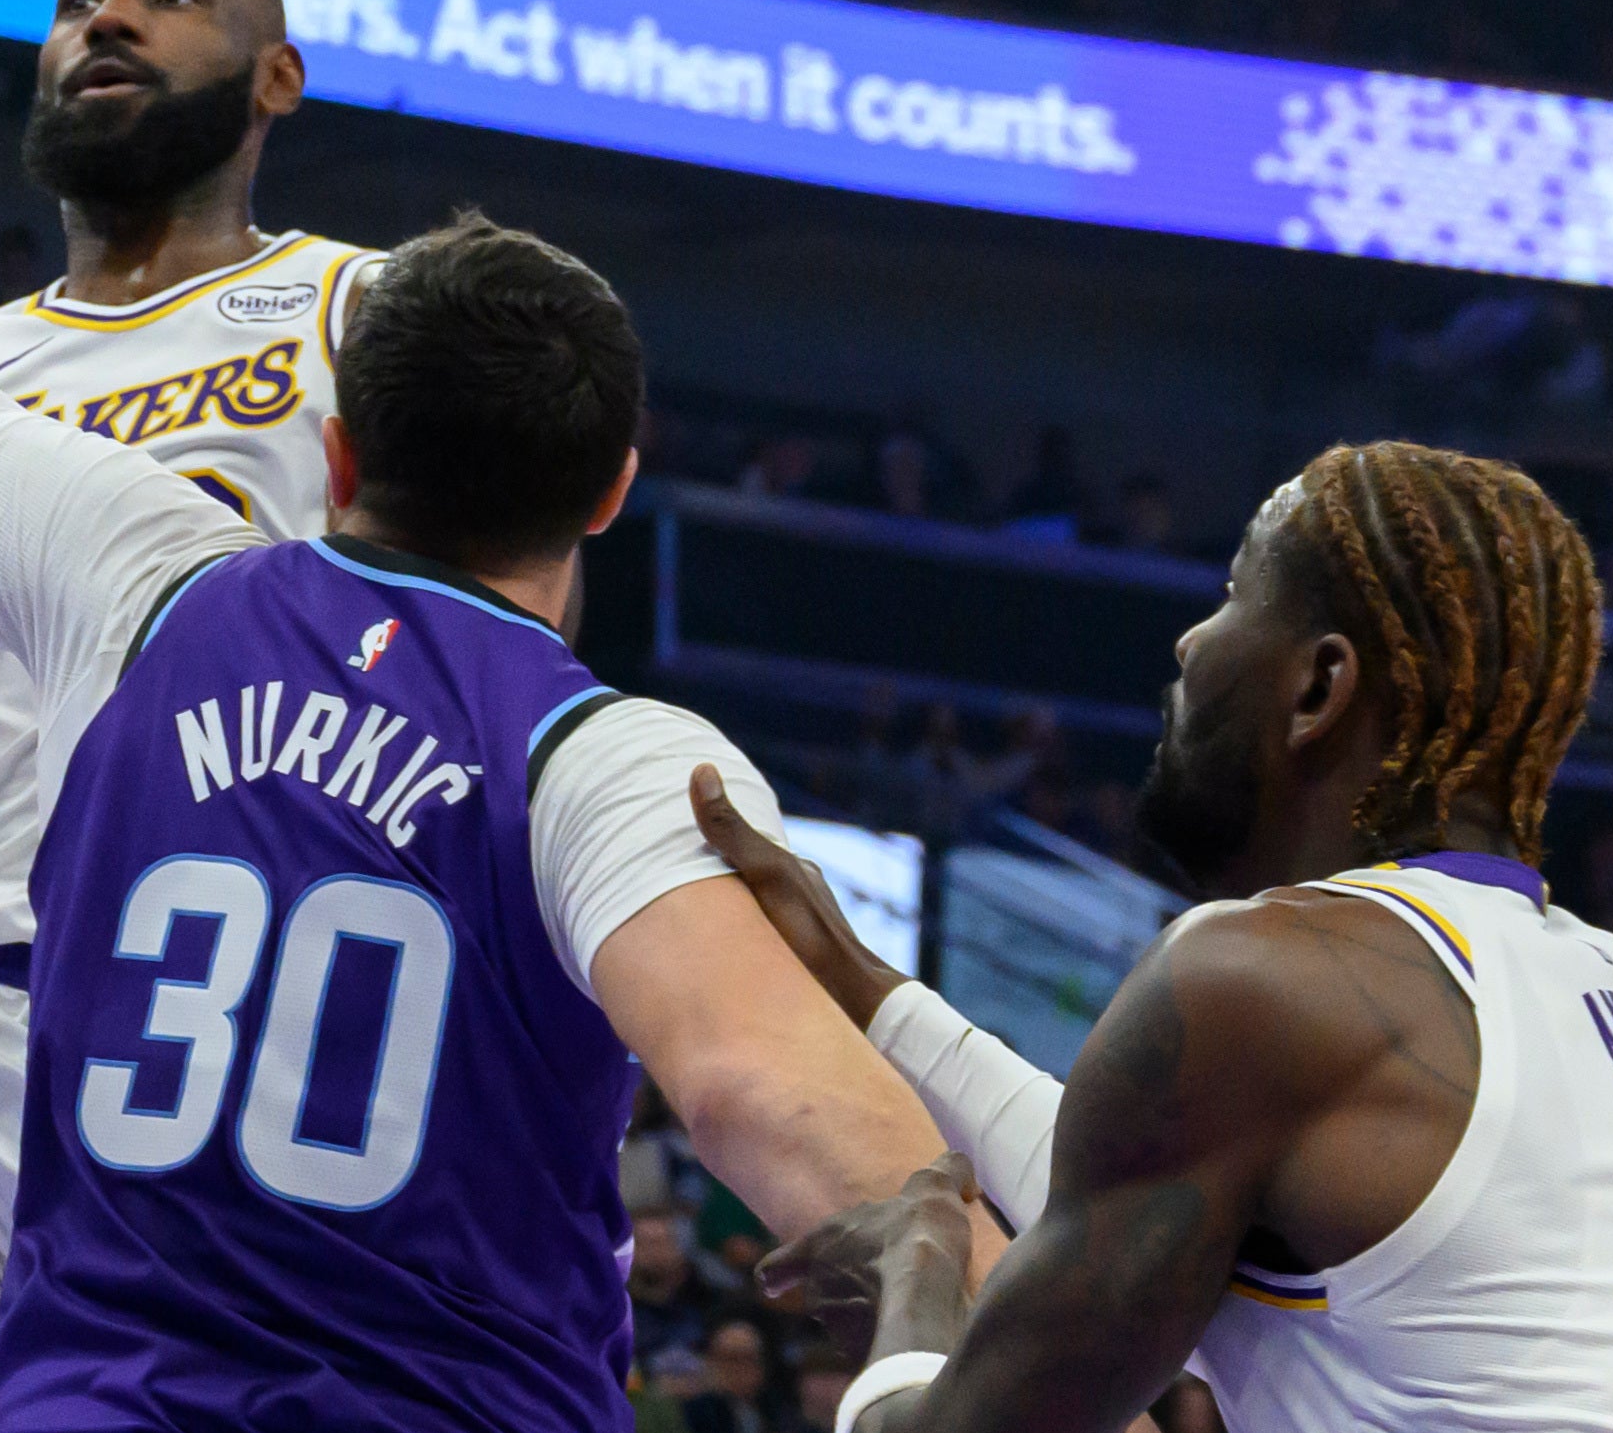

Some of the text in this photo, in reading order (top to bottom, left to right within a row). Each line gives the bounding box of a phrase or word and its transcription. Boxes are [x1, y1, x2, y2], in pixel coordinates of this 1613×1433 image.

[576, 15, 770, 123] when
[782, 42, 838, 133] it
[846, 75, 1138, 177] counts.
[16, 339, 305, 447] KERS
[76, 852, 457, 1213] 30
